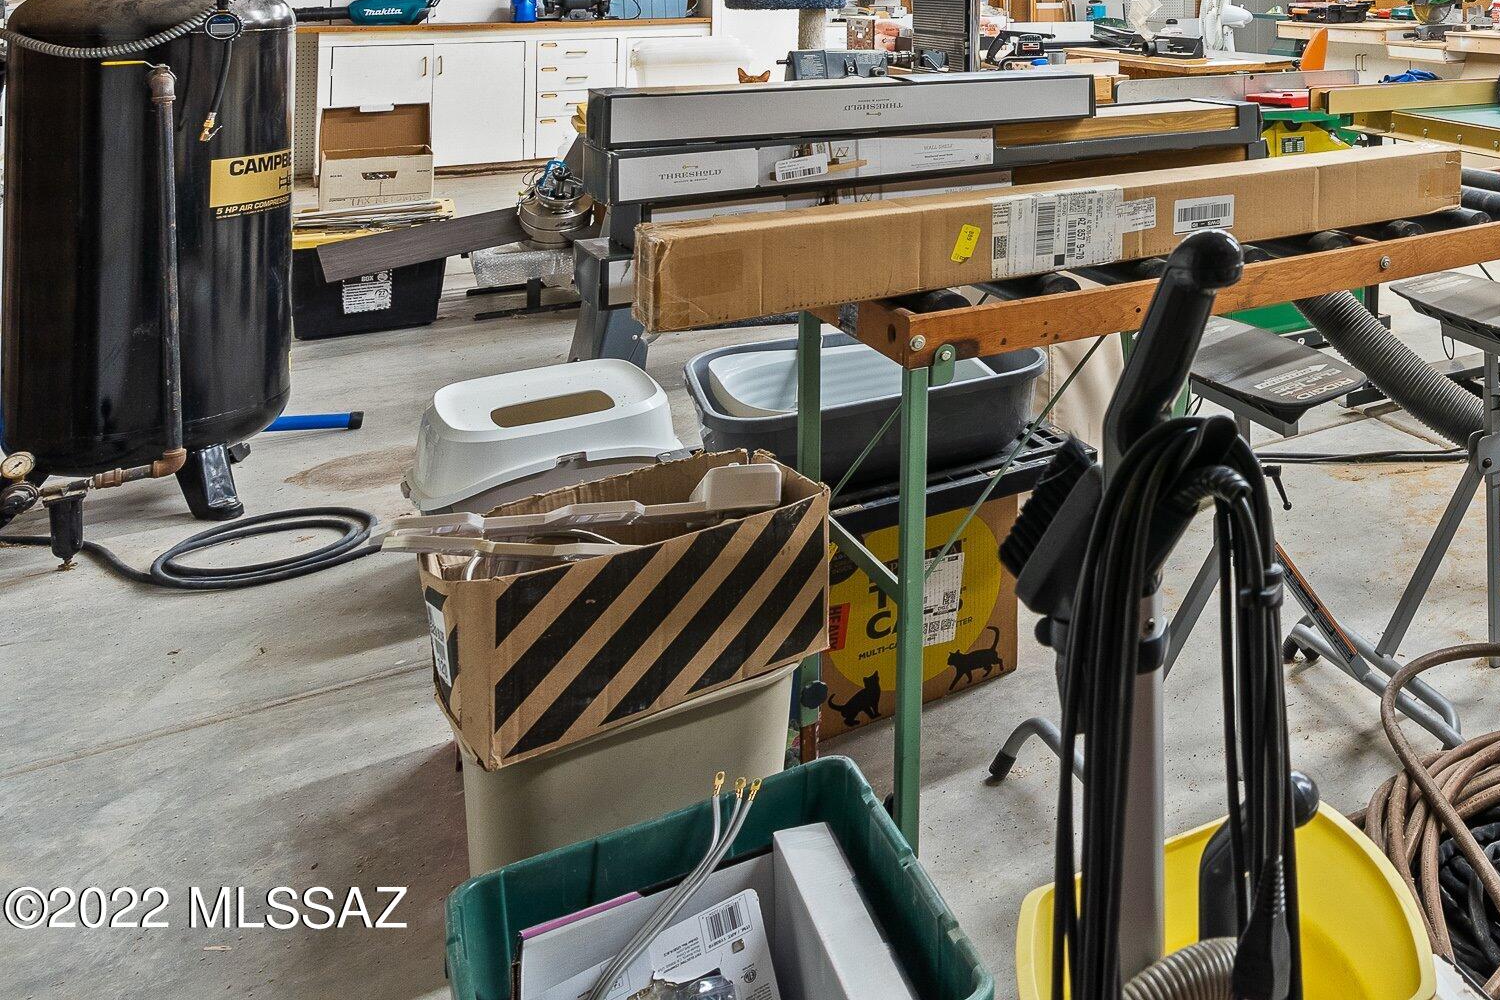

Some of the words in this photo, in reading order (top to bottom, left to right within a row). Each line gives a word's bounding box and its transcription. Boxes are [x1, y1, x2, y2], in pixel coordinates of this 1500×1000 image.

[216, 207, 223, 215] 5
[225, 205, 238, 214] HP
[239, 203, 253, 212] AIR
[1076, 228, 1086, 241] 857
[1296, 377, 1356, 401] RIDGID
